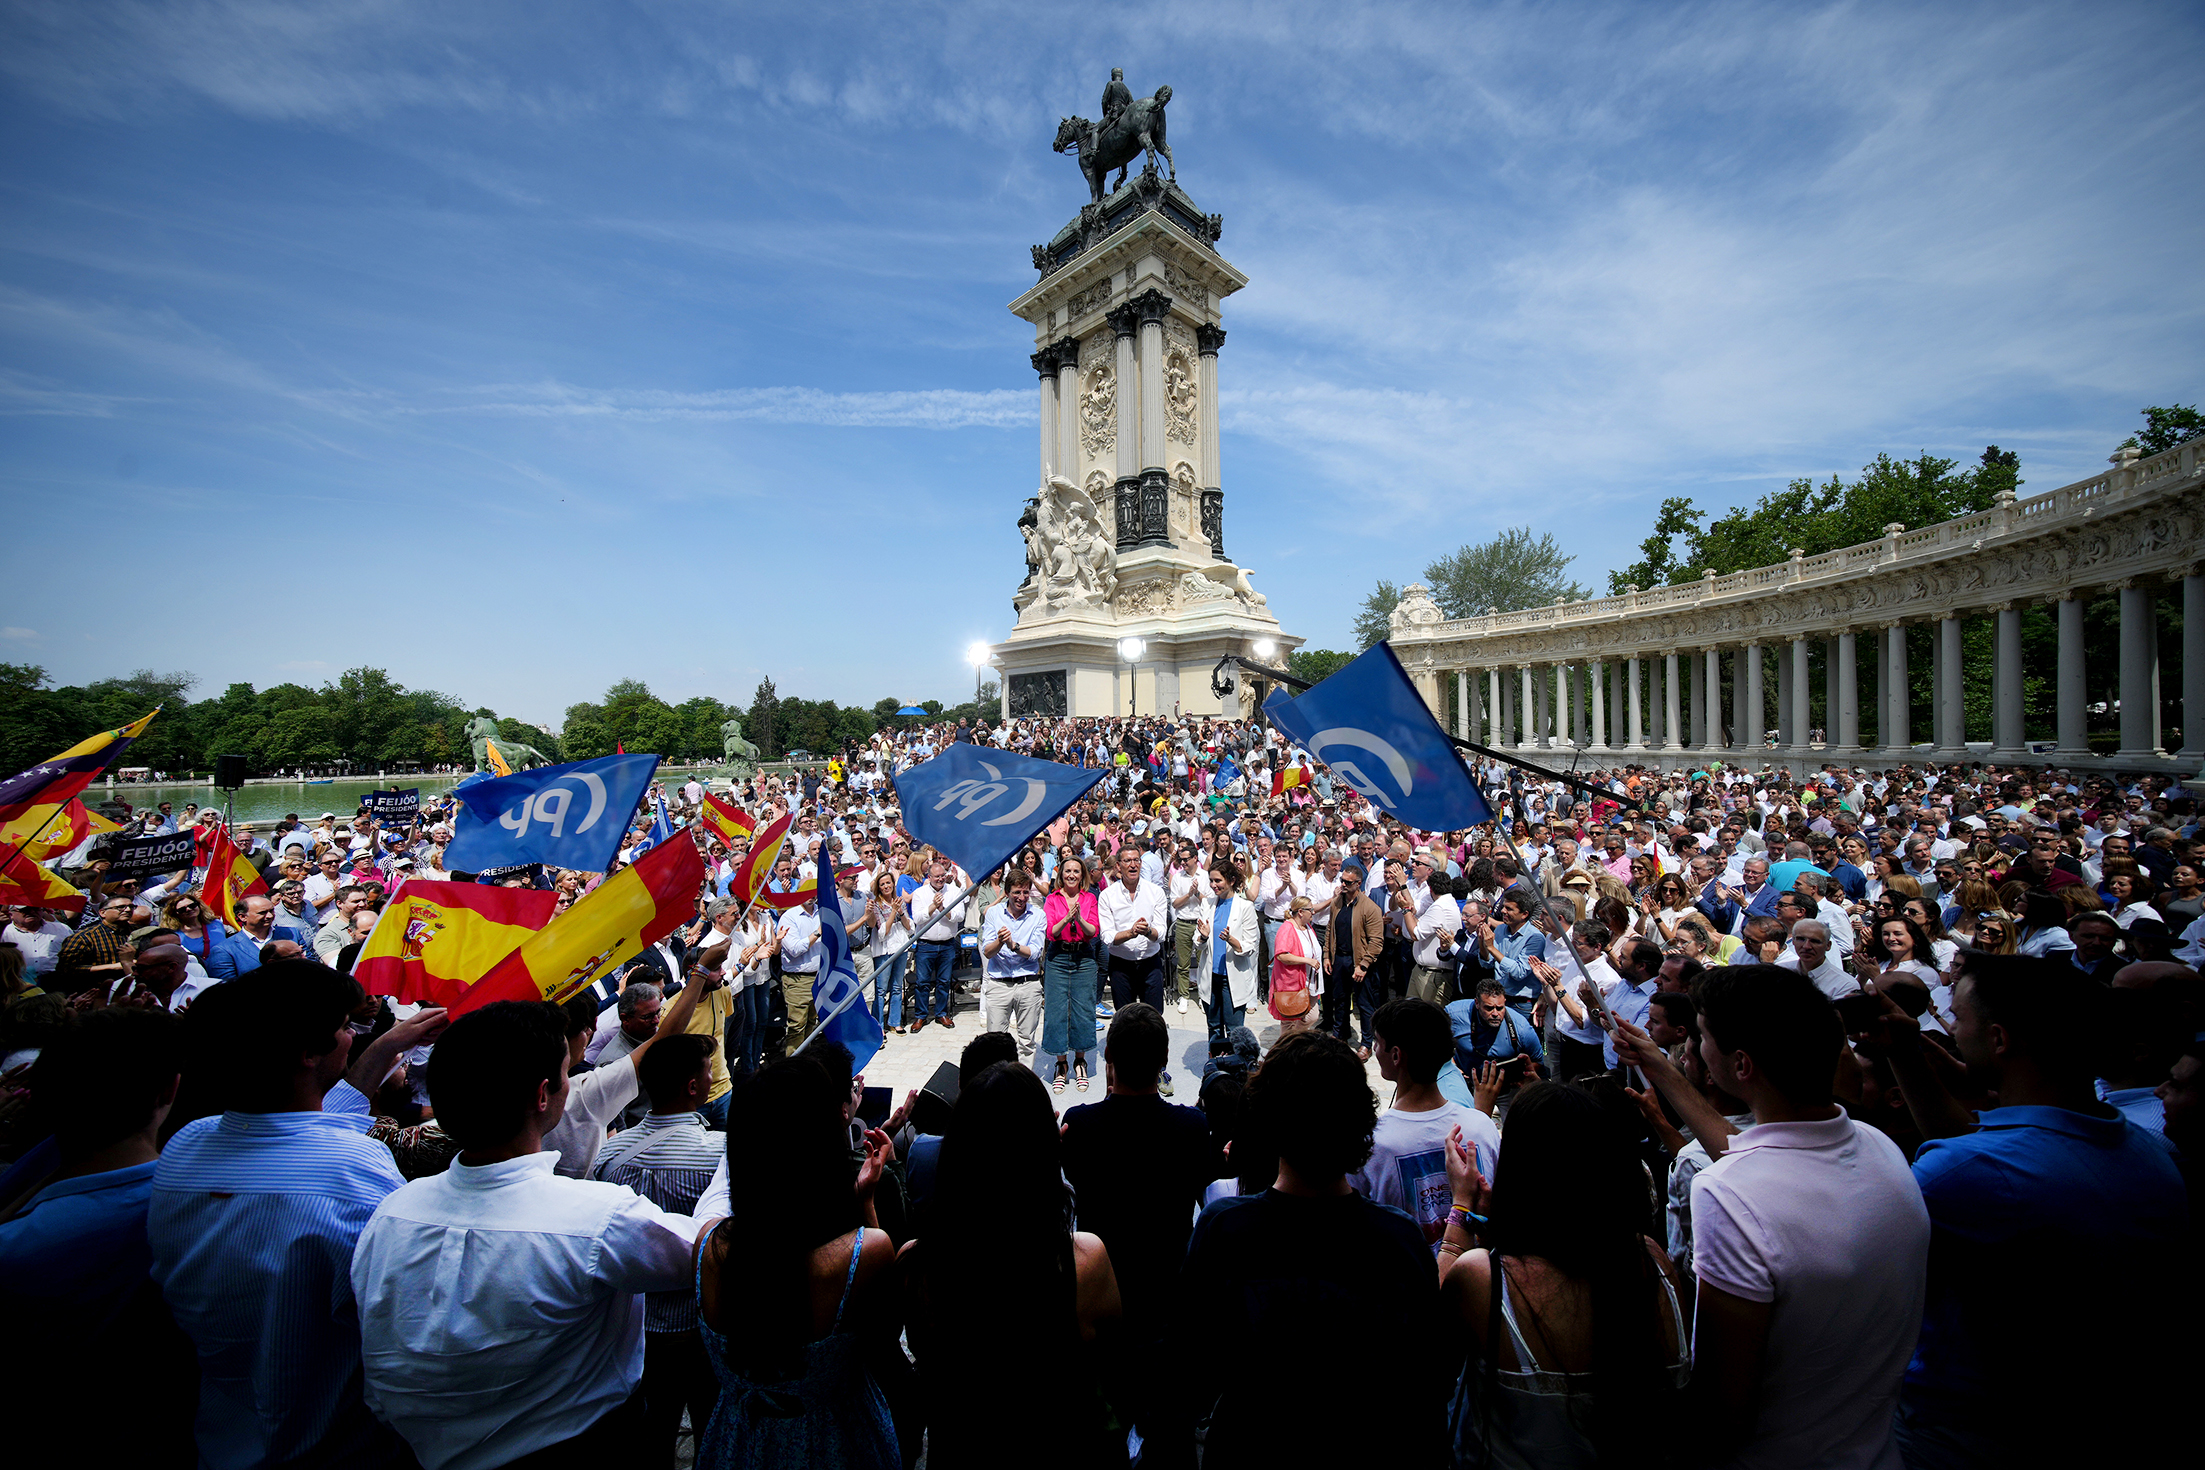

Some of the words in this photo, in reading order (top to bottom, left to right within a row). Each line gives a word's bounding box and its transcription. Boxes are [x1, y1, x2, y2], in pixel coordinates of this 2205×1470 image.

[377, 794, 417, 806] FEIJÓO
[121, 840, 189, 860] FEIJÓO
[113, 851, 192, 869] PRESIDENTE
